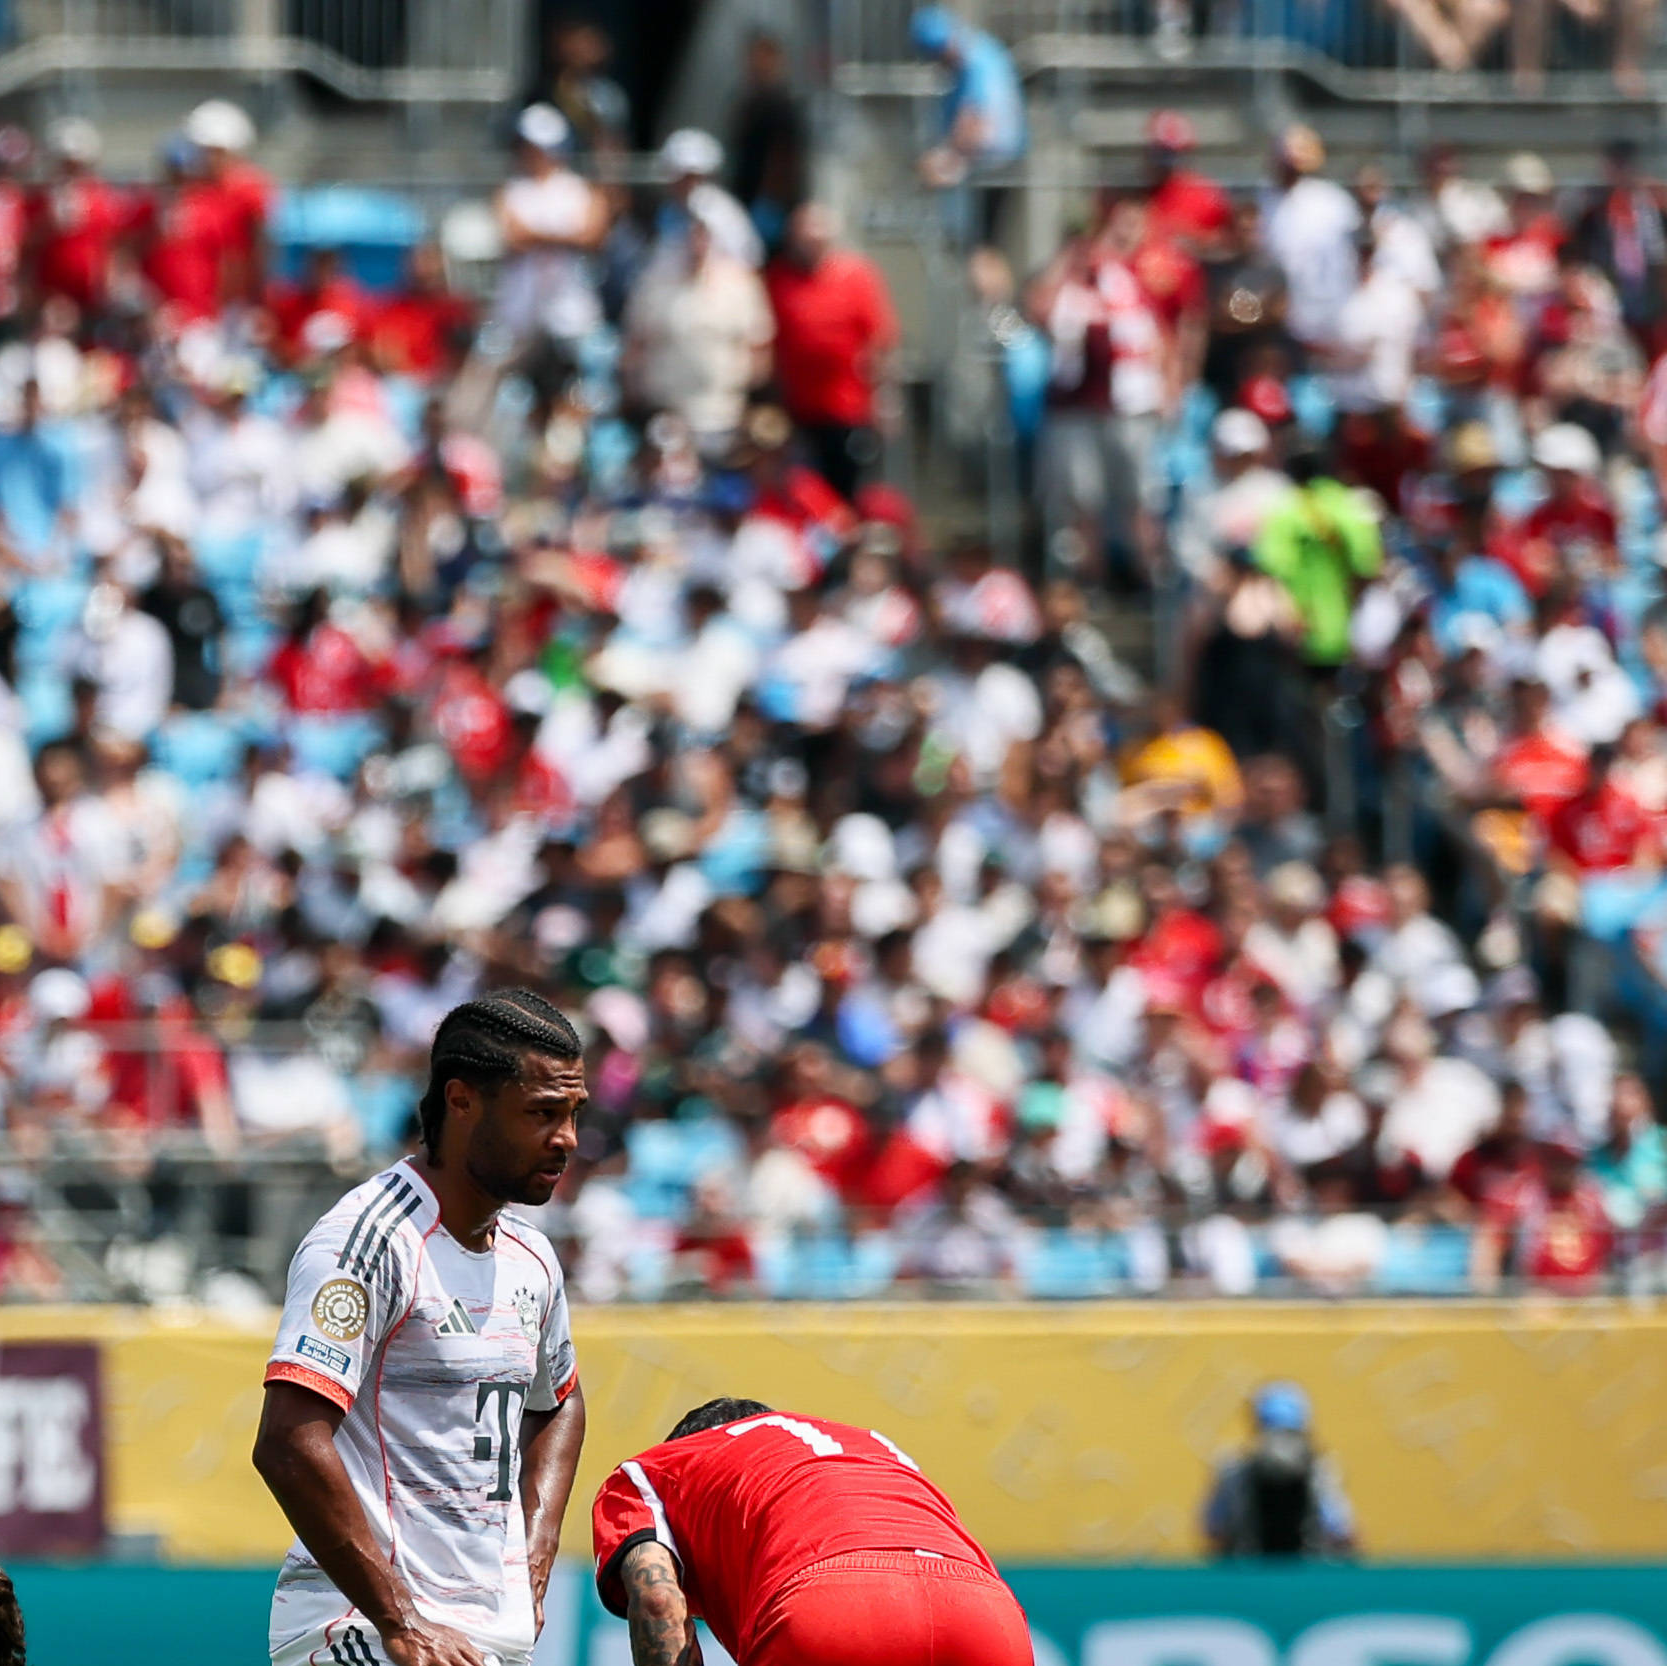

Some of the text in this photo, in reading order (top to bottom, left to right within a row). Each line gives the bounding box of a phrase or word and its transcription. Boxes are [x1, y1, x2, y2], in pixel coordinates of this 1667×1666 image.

[323, 1284, 353, 1298] WORLD
[353, 1289, 365, 1306] CUP
[322, 1322, 345, 1338] FIFA
[473, 1381, 530, 1501] T
